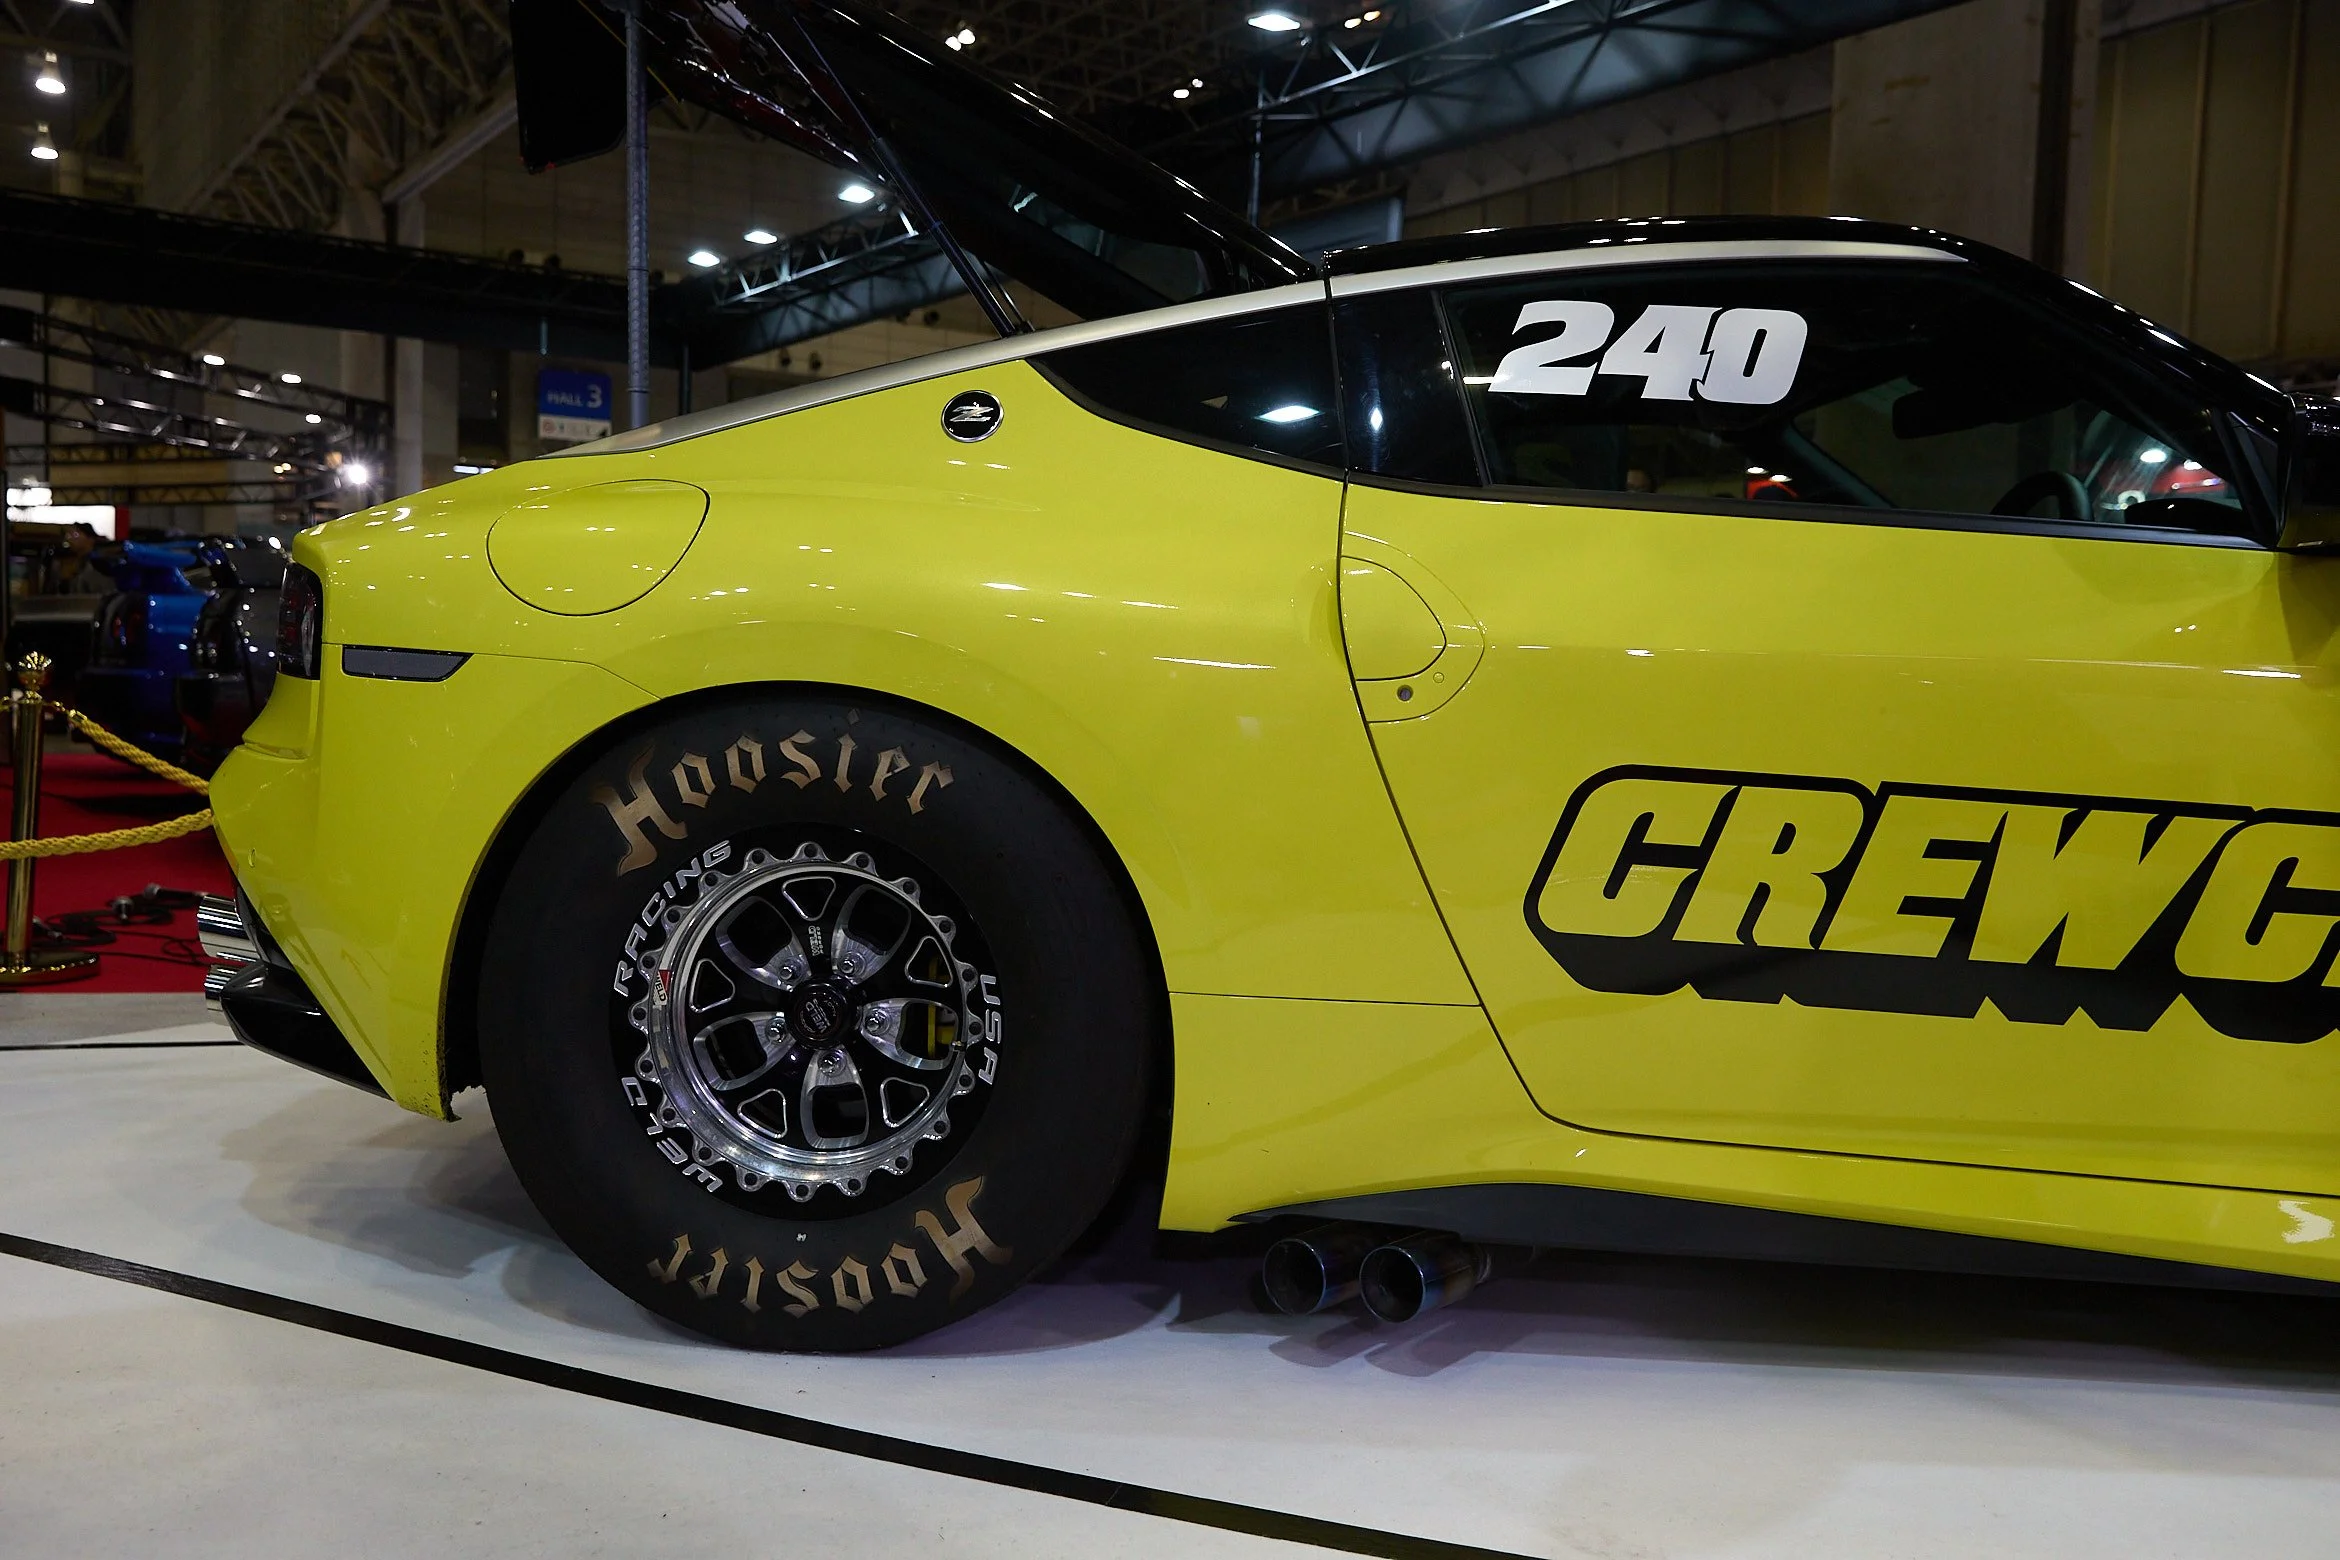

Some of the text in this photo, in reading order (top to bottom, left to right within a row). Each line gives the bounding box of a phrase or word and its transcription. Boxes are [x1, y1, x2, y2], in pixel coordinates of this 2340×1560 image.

[546, 383, 603, 409] HALL 3
[1488, 300, 1808, 404] 240
[595, 710, 954, 878] Hoosier
[613, 839, 732, 998] RACING
[978, 974, 1002, 1086] USA
[620, 1076, 724, 1193] WELD
[646, 1174, 1013, 1320] Hoosier
